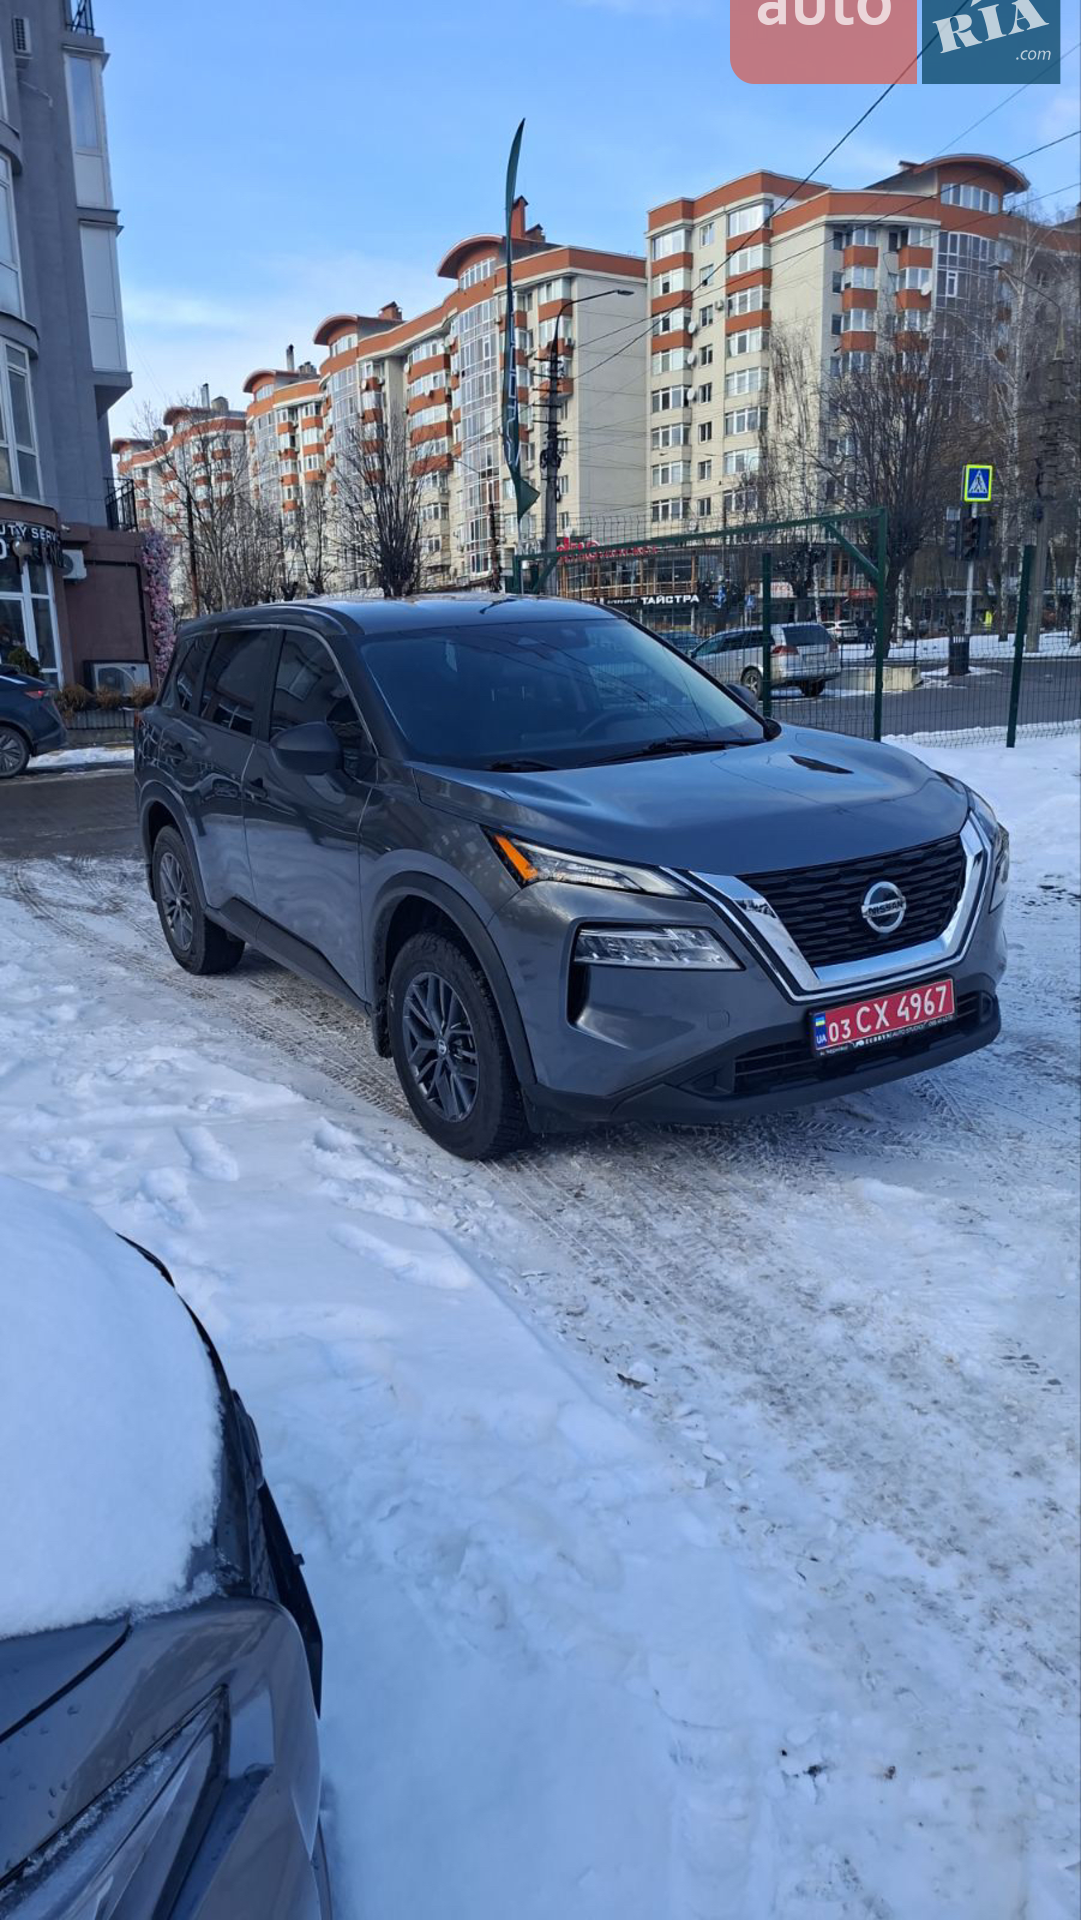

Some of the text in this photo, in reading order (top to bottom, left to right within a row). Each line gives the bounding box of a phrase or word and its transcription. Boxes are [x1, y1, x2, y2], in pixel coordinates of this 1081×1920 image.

[641, 594, 700, 606] ТАЙСТРА
[828, 1019, 851, 1042] 03
[897, 985, 947, 1022] 4967
[816, 1034, 828, 1045] UA
